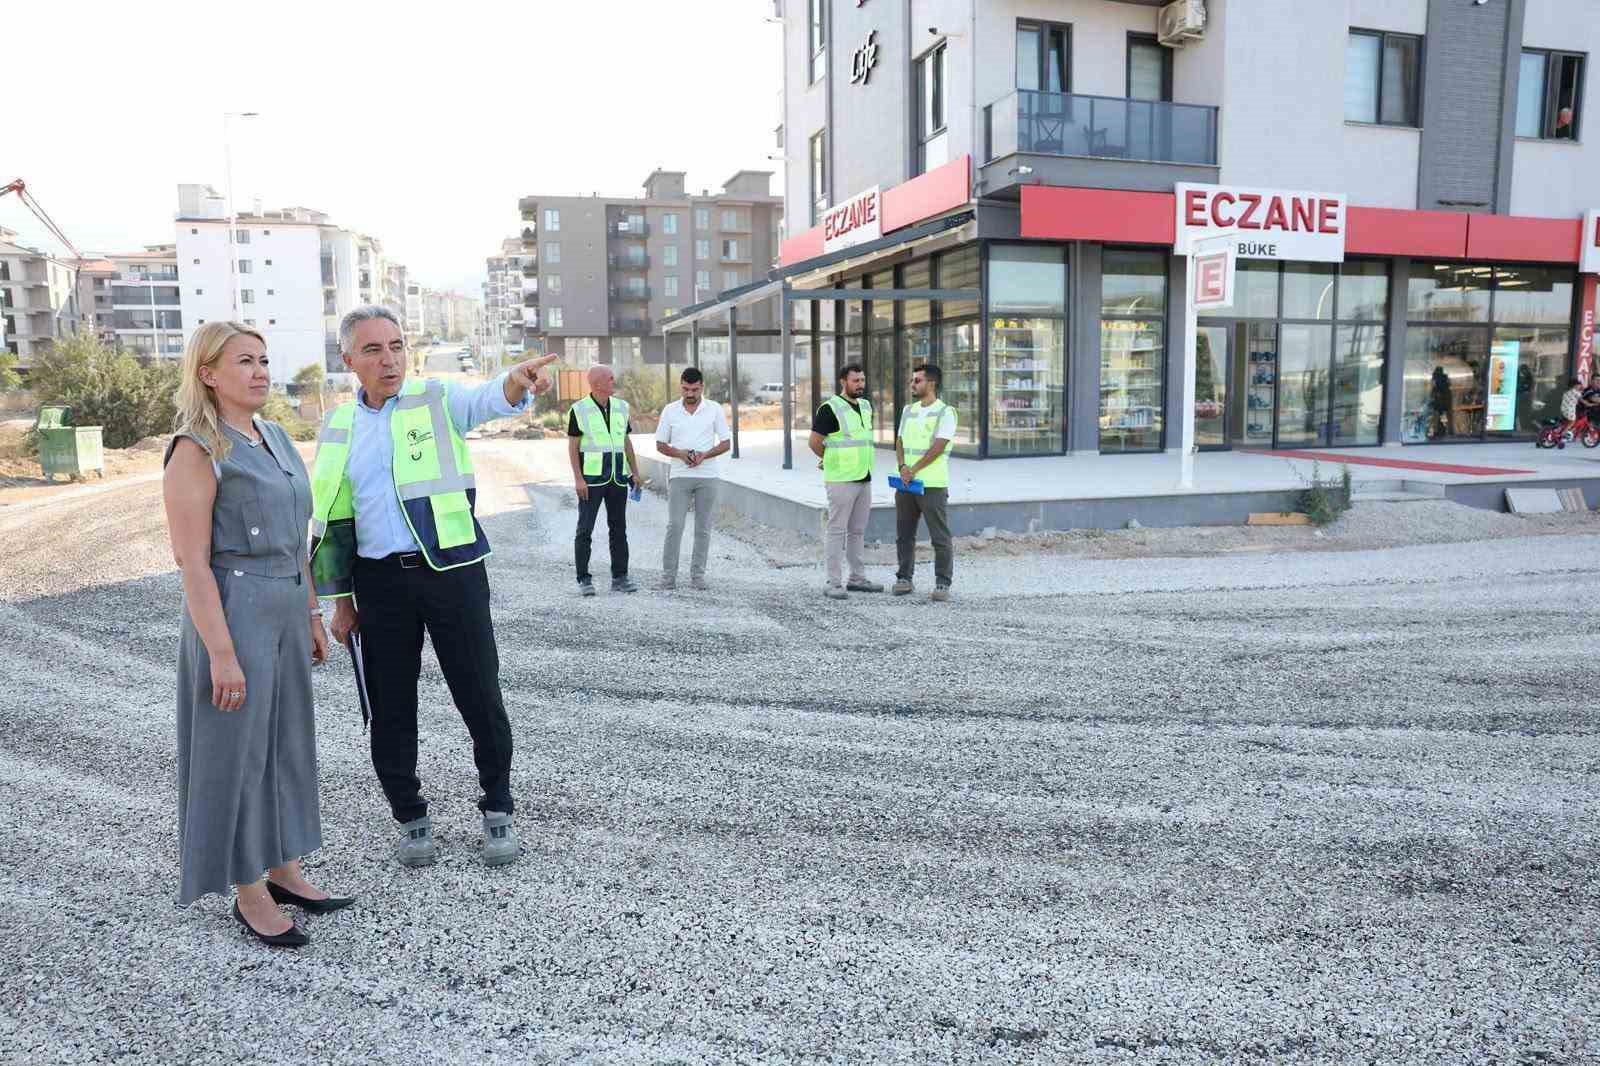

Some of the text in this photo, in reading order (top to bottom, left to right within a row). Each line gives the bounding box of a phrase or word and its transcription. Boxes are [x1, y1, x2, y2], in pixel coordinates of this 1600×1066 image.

[825, 192, 876, 241] ECZANE
[1185, 189, 1339, 234] ECZANE
[1238, 241, 1277, 256] BÜKE
[1201, 262, 1221, 296] E
